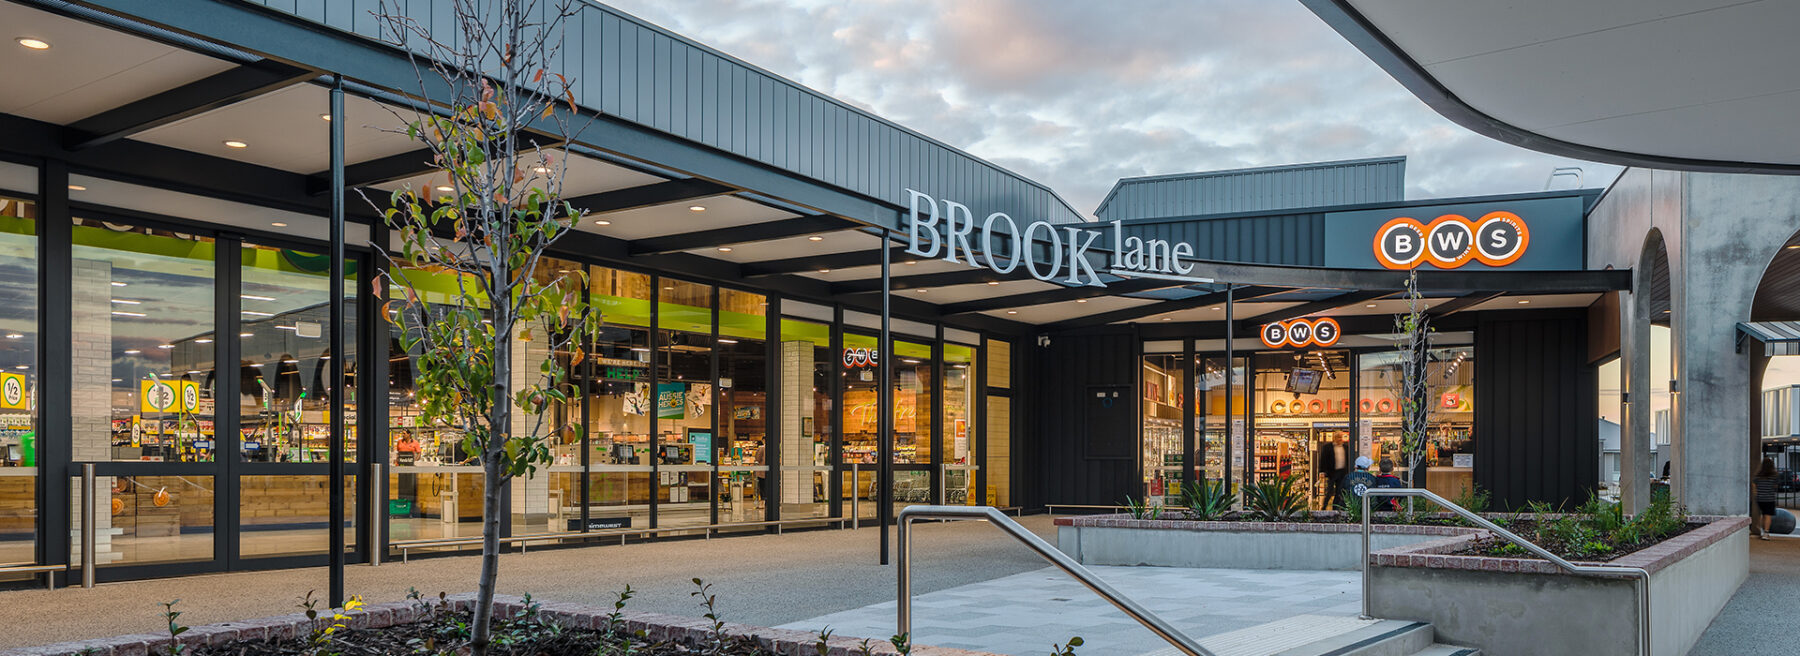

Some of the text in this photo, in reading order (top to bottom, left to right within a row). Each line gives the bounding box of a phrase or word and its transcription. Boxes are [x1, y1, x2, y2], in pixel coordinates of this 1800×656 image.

[1409, 224, 1424, 237] BEER
[1501, 217, 1522, 236] SPIRITS
[905, 188, 1195, 288] BROOK lane
[1395, 229, 1508, 253] BWS
[1456, 244, 1473, 260] WINE
[1271, 326, 1330, 339] BWS
[607, 367, 640, 380] HELP
[8, 382, 18, 395] 1/2
[660, 391, 684, 400] AUSSIE
[1271, 398, 1403, 414] COOLROO
